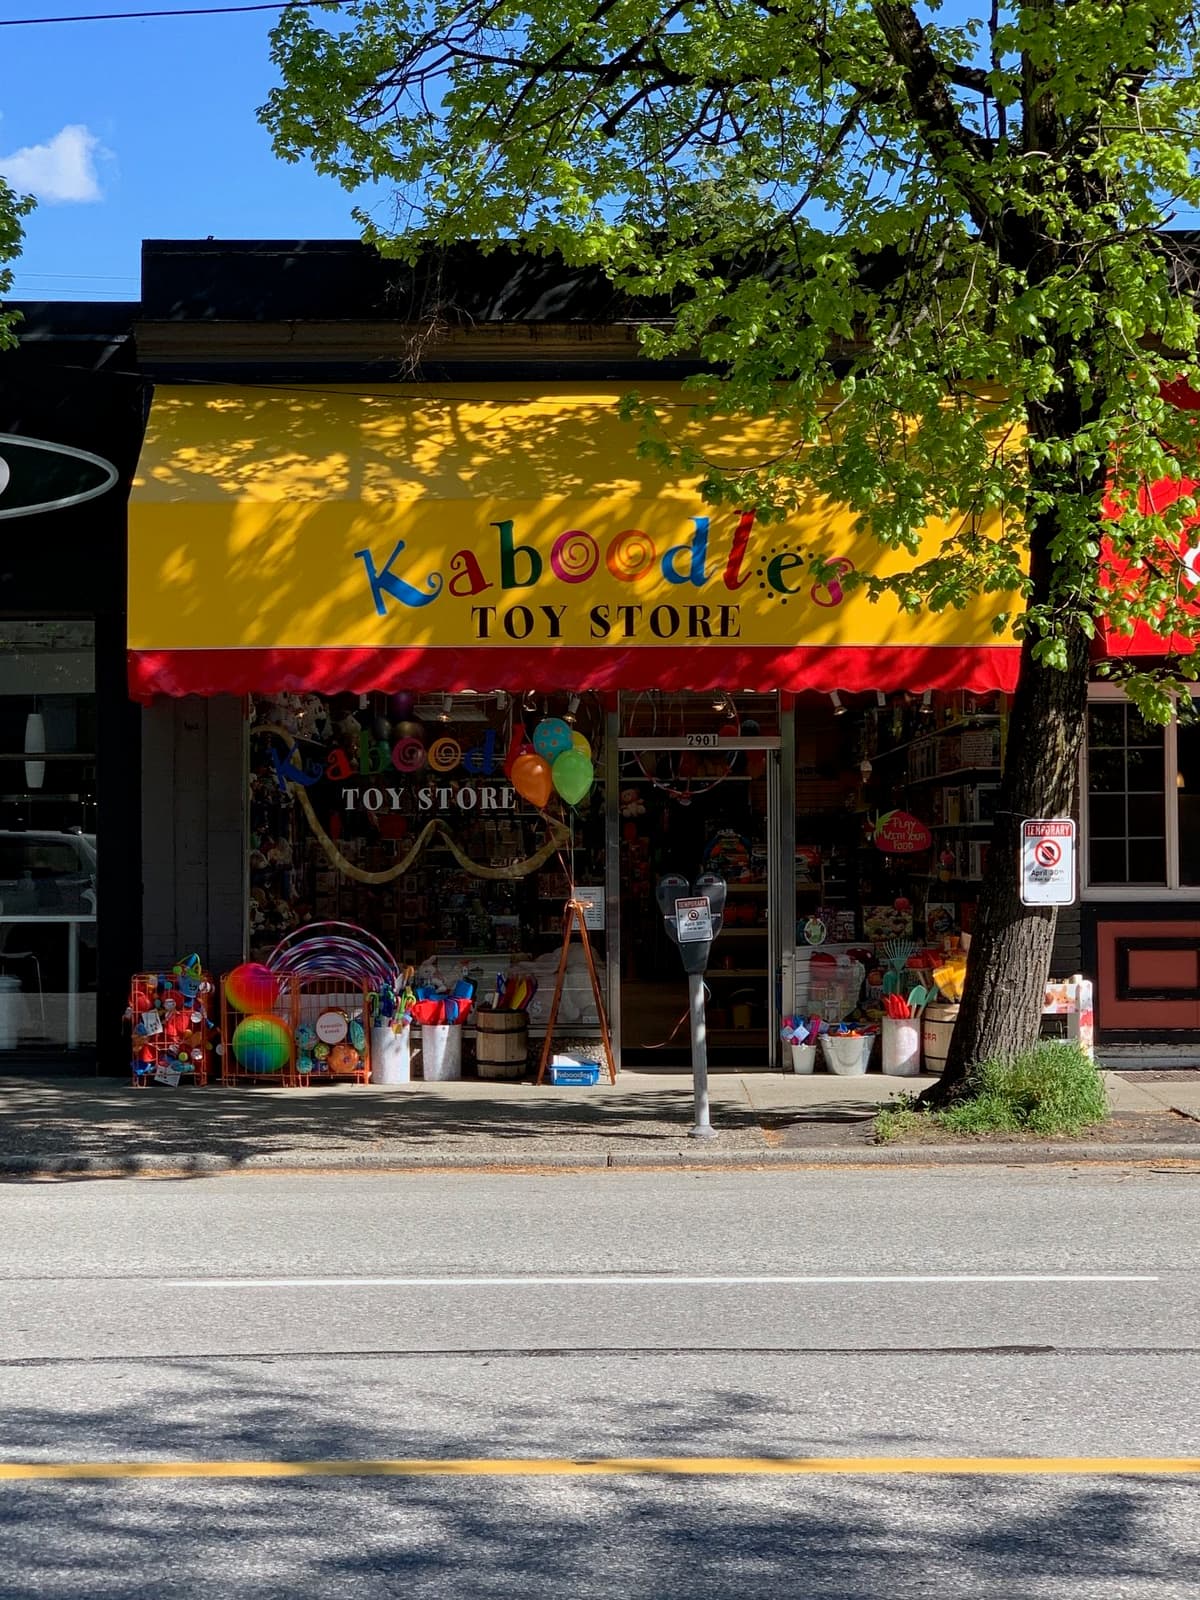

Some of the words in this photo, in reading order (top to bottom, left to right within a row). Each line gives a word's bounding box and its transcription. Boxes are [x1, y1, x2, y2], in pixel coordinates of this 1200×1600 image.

[353, 508, 856, 617] Kaboodles
[470, 603, 569, 640] TOY
[590, 603, 742, 640] STORE
[687, 734, 718, 746] 2901
[271, 723, 528, 792] Kaboodl
[341, 787, 405, 811] TOY
[417, 786, 517, 811] STORE
[1026, 824, 1071, 837] TEMPORARY
[1030, 869, 1048, 878] April
